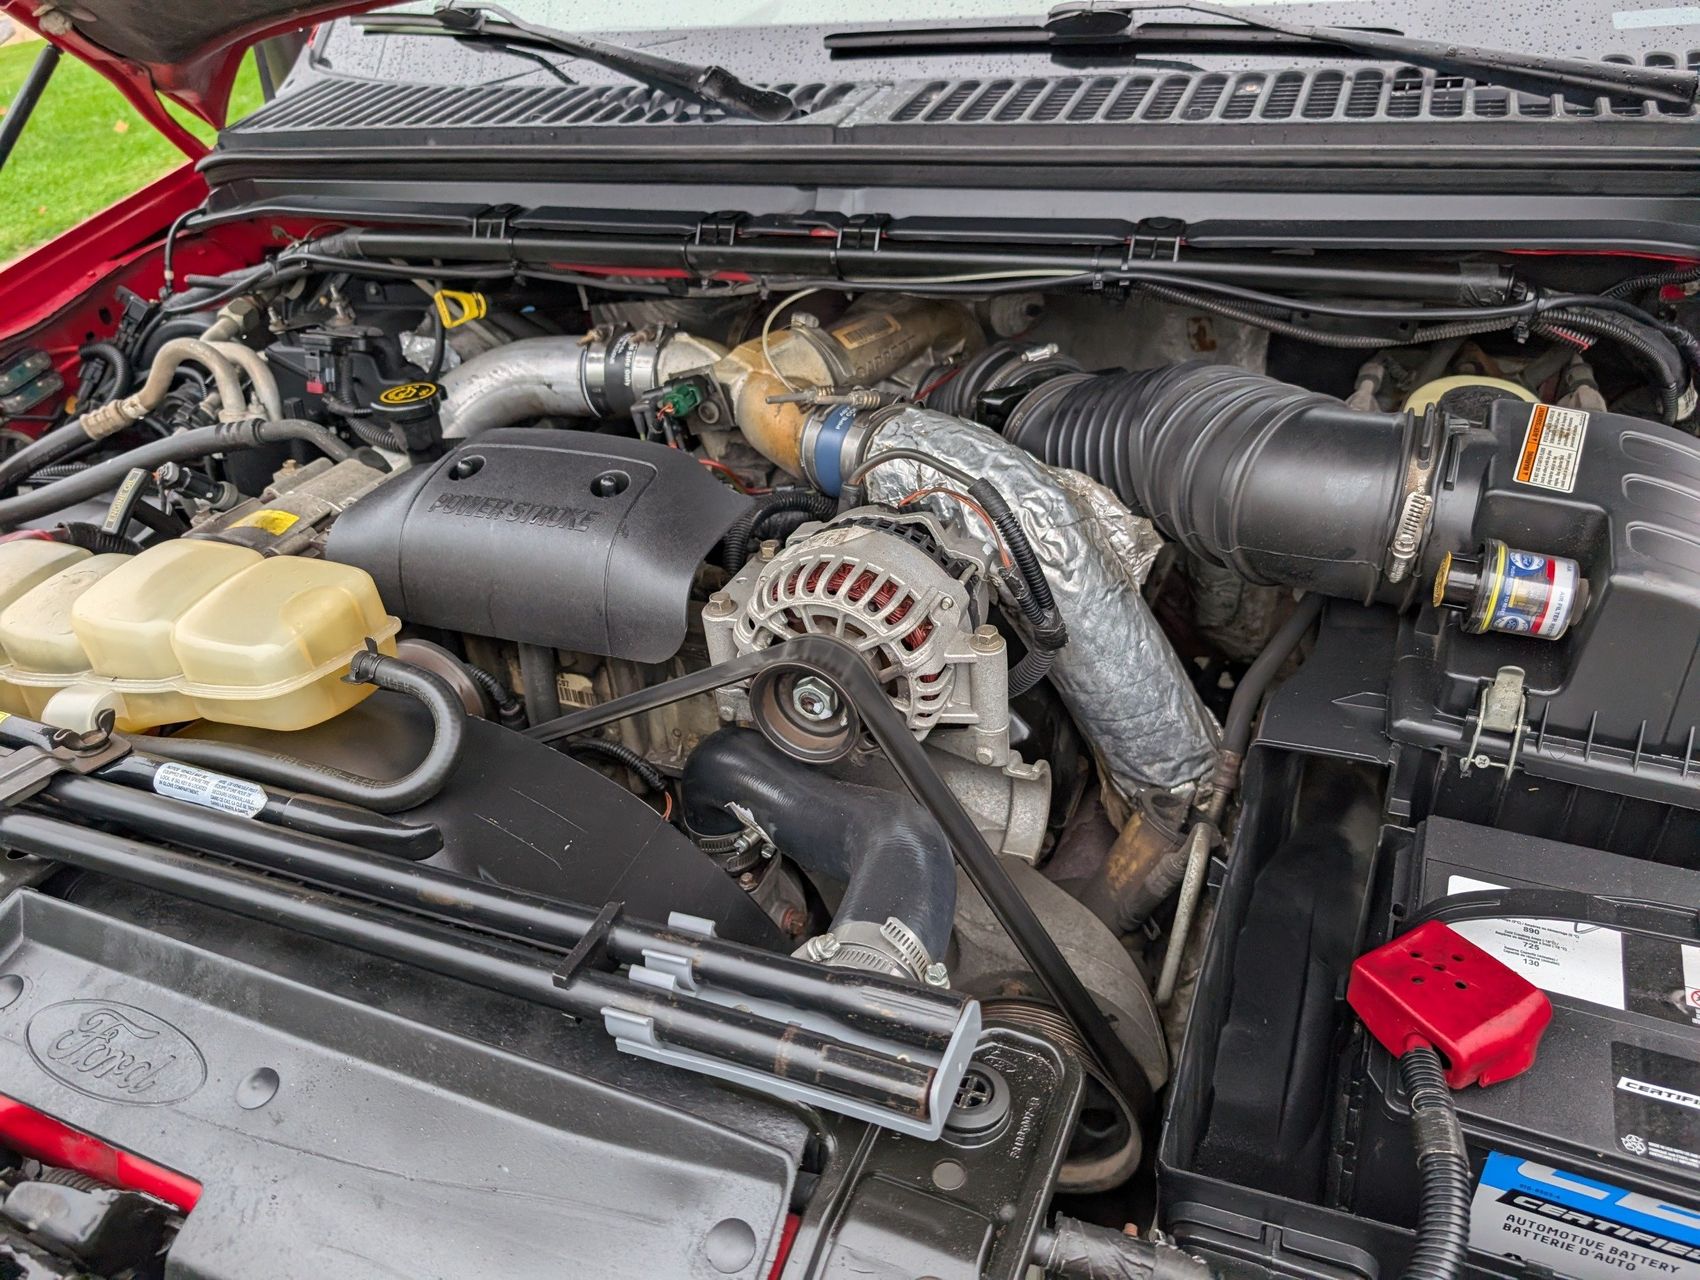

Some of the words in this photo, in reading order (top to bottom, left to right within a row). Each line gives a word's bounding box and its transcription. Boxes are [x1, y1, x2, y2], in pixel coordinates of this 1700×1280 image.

[428, 492, 513, 520] POWER
[506, 502, 600, 532] STROKE
[1523, 926, 1540, 935] 890
[1523, 941, 1540, 951] 725
[1523, 958, 1540, 967] 130
[47, 1008, 177, 1094] Ford
[1625, 1081, 1700, 1106] CERTIFI
[1502, 1223, 1575, 1257] BATTERIE
[1579, 1248, 1636, 1272] D'AUTO
[1505, 1213, 1606, 1250] AUTOMOTIVE
[1609, 1246, 1681, 1274] BATTERY
